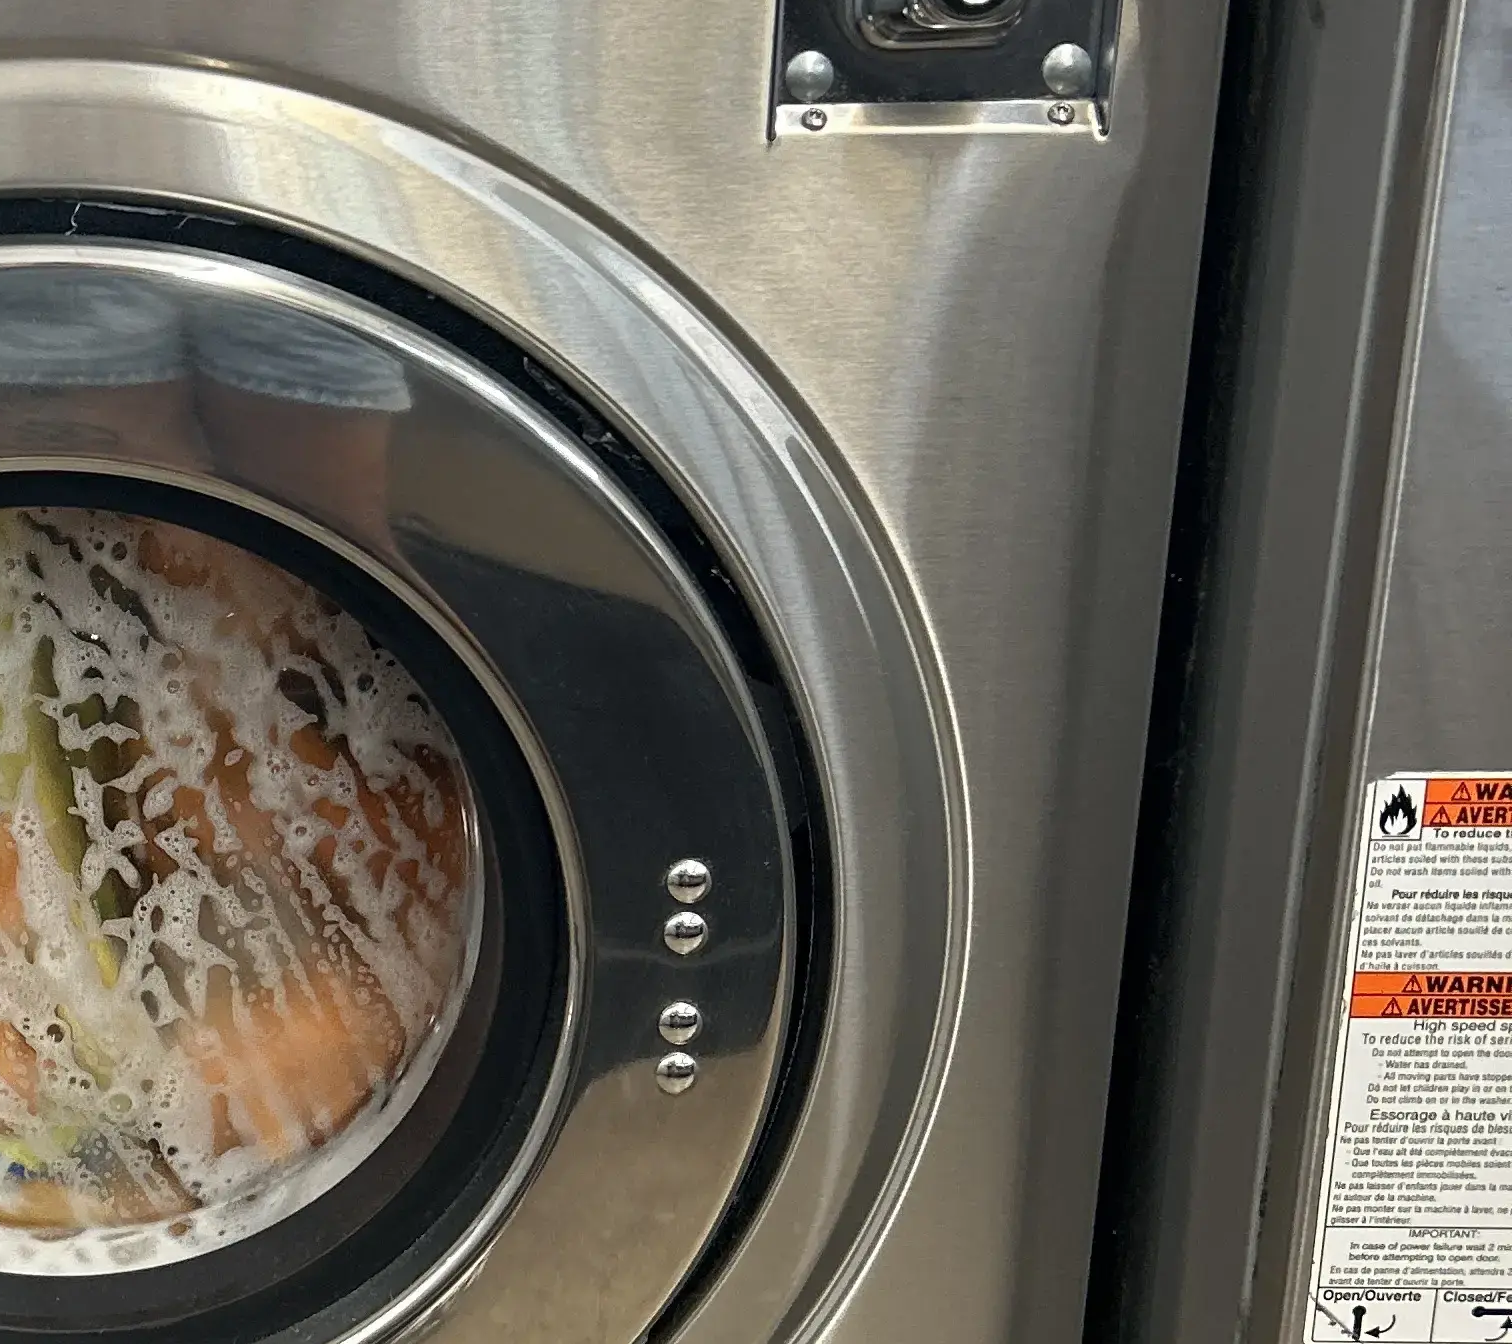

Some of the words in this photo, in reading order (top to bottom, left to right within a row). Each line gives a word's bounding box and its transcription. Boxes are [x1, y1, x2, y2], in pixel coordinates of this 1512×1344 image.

[1433, 828, 1449, 838] To
[1453, 828, 1501, 838] reduce
[1373, 843, 1386, 851] Do
[1392, 889, 1418, 899] Pour
[1420, 889, 1459, 899] réduire
[1413, 1020, 1446, 1033] High
[1451, 1020, 1496, 1032] speed
[1362, 1033, 1376, 1044] To
[1380, 1033, 1421, 1044] reduce
[1425, 1033, 1444, 1044] the
[1448, 1033, 1471, 1045] risk
[1474, 1033, 1486, 1045] of
[1369, 1109, 1437, 1123] Essorage
[1441, 1108, 1450, 1121] à
[1455, 1109, 1495, 1121] haute
[1344, 1122, 1369, 1133] Pour
[1372, 1122, 1408, 1133] réduire
[1412, 1122, 1426, 1133] les
[1430, 1122, 1468, 1135] risques
[1472, 1122, 1484, 1133] de
[1323, 1289, 1422, 1302] Open/Ouverte
